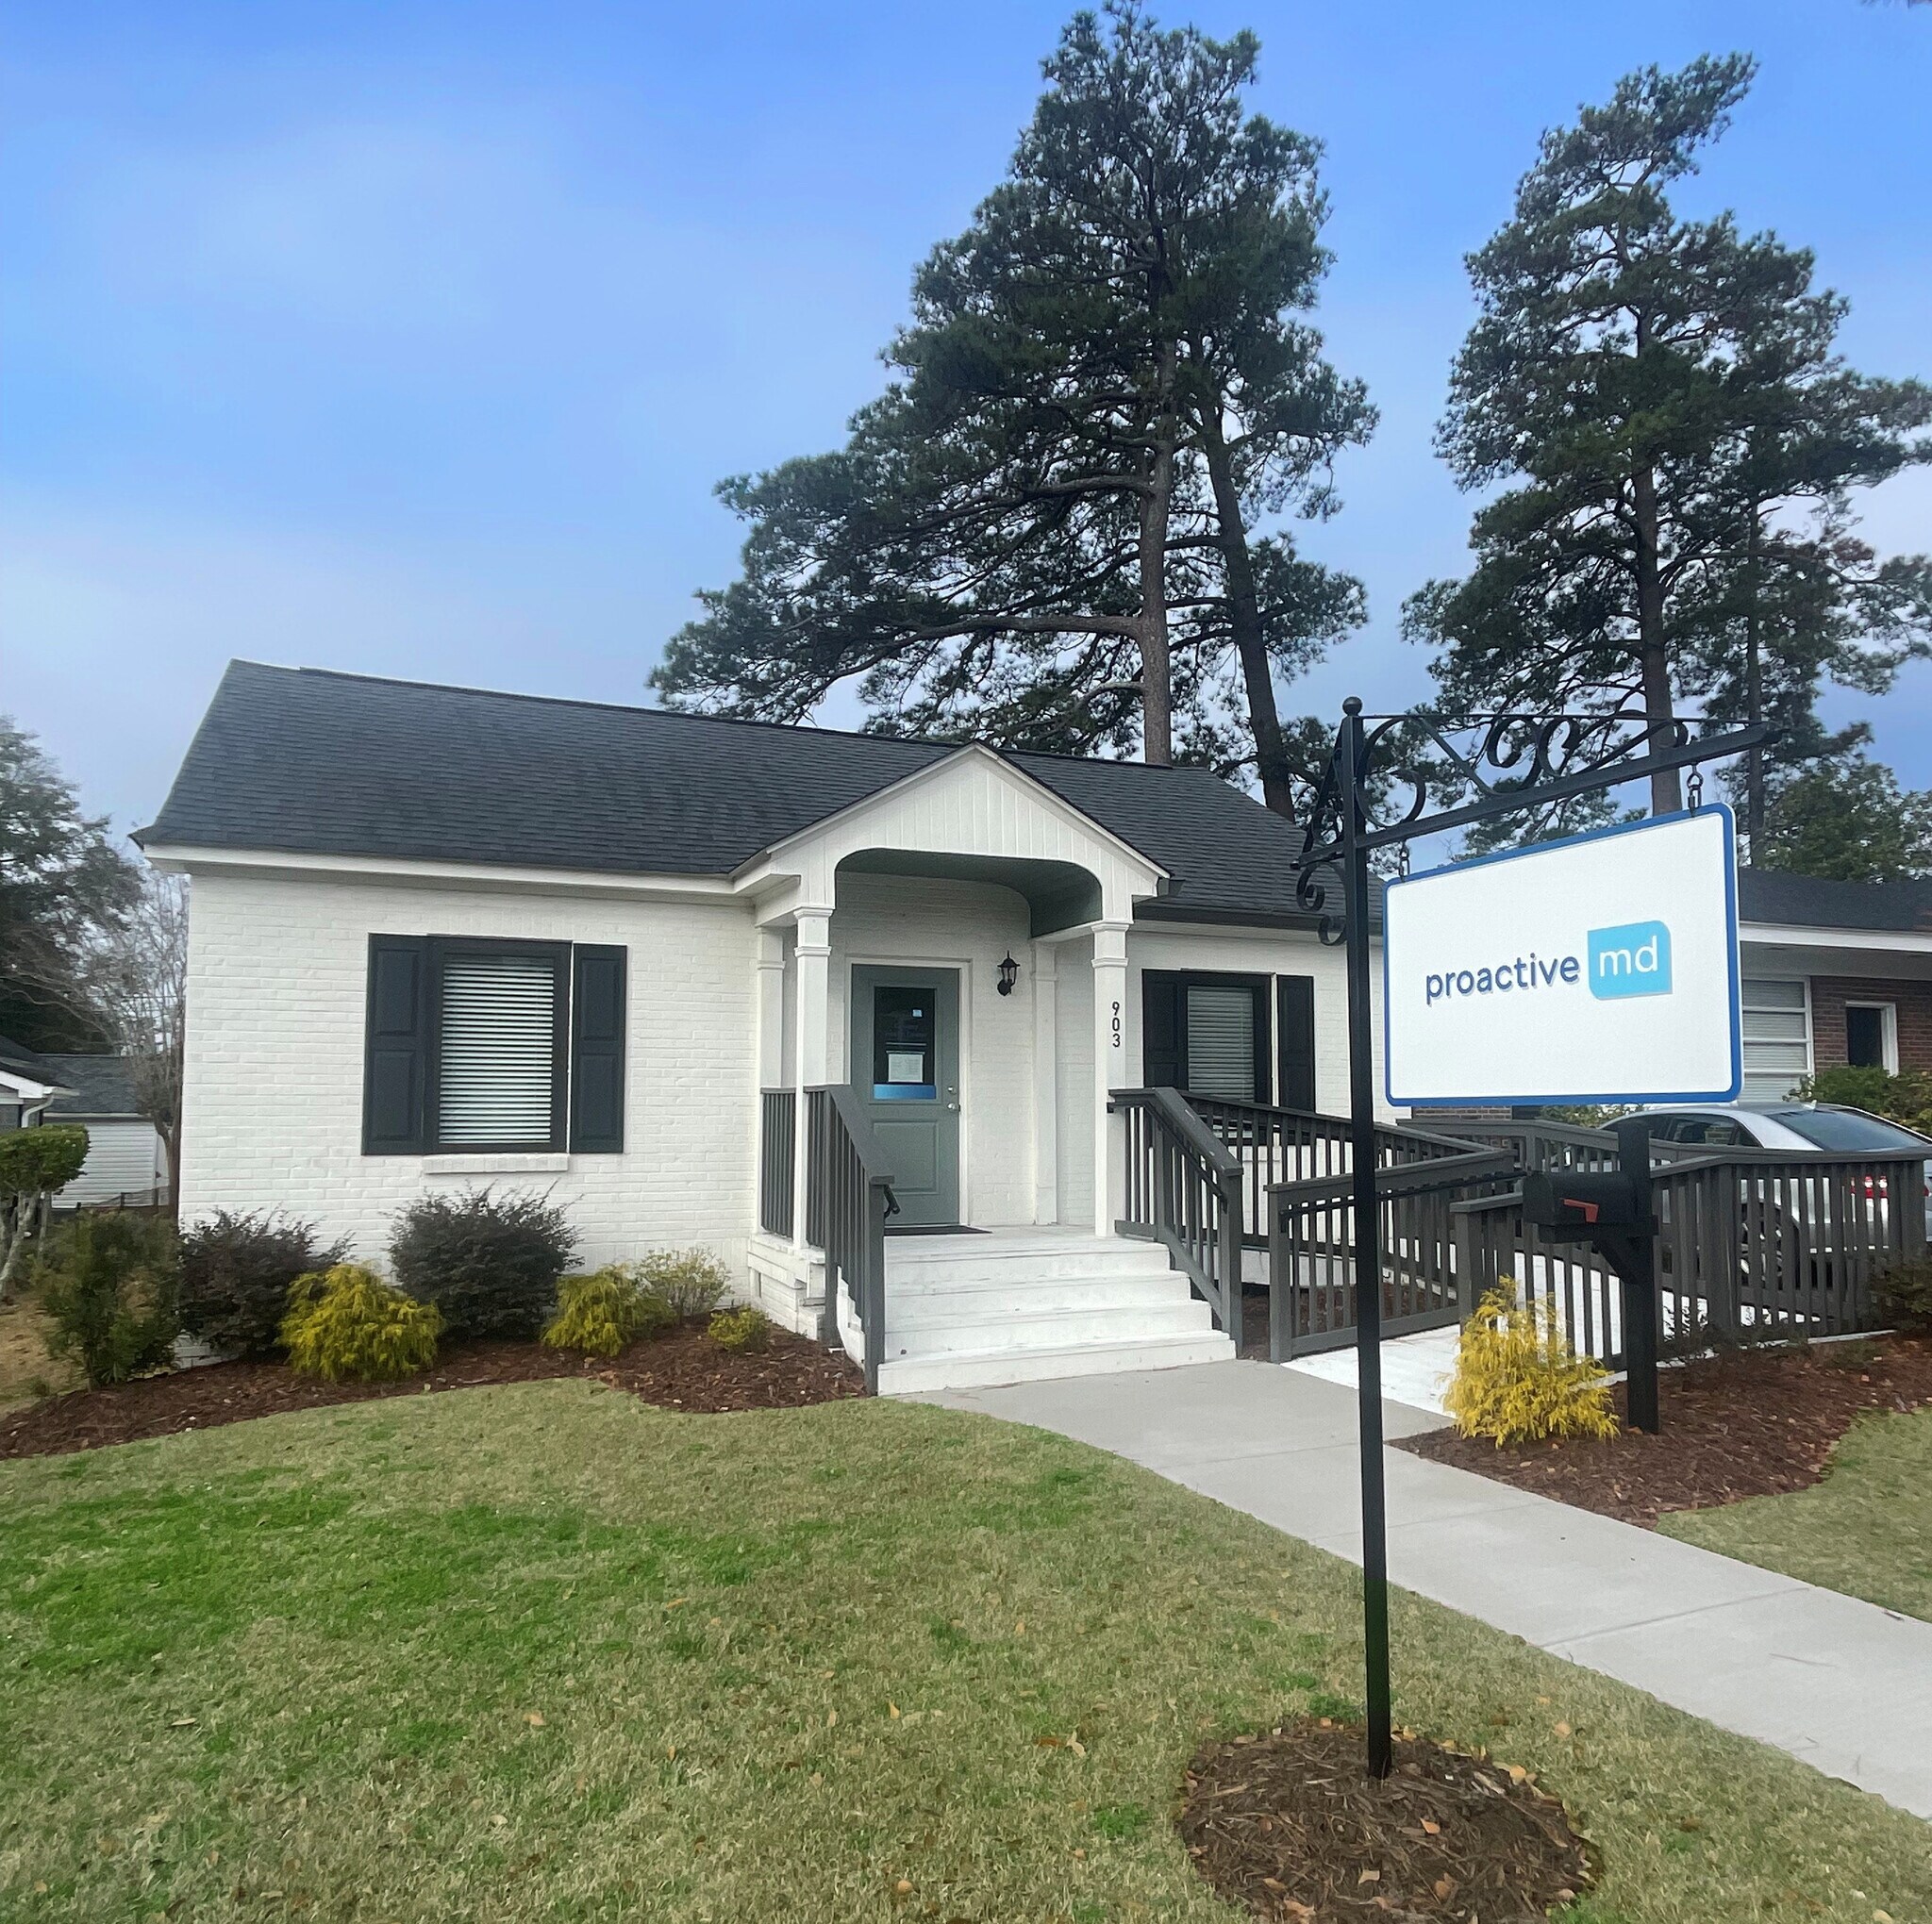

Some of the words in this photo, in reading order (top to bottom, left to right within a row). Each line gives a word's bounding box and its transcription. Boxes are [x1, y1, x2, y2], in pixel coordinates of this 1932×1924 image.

[1425, 953, 1580, 1006] proactive
[1599, 935, 1657, 977] md
[1112, 1001, 1121, 1048] 903
